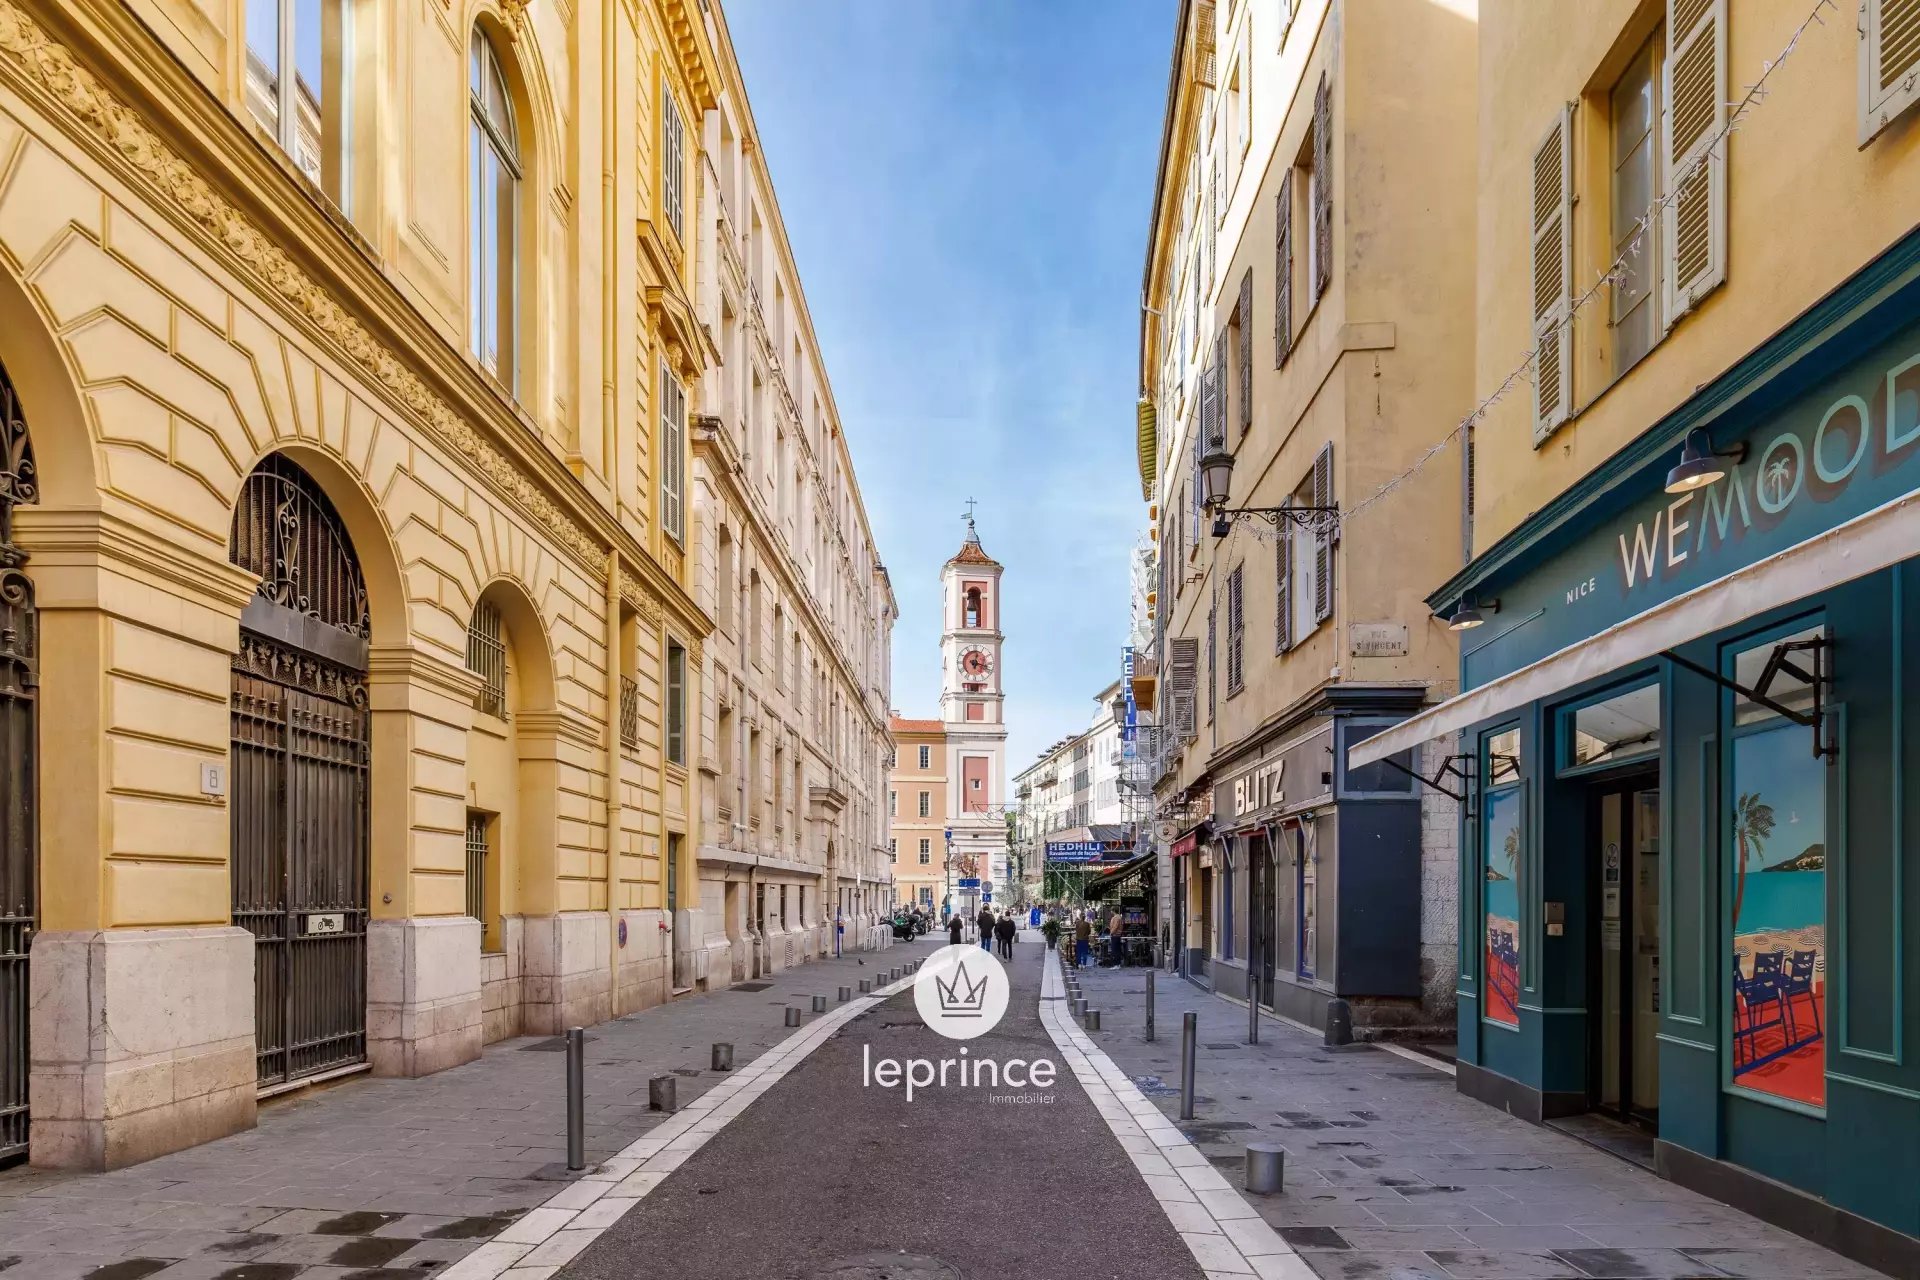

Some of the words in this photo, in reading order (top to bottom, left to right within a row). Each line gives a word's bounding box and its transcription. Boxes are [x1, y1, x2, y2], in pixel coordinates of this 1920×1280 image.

[1566, 577, 1596, 605] NICE
[209, 769, 218, 789] 8
[1235, 759, 1284, 817] BLITZ
[1049, 843, 1100, 851] HEDHILI
